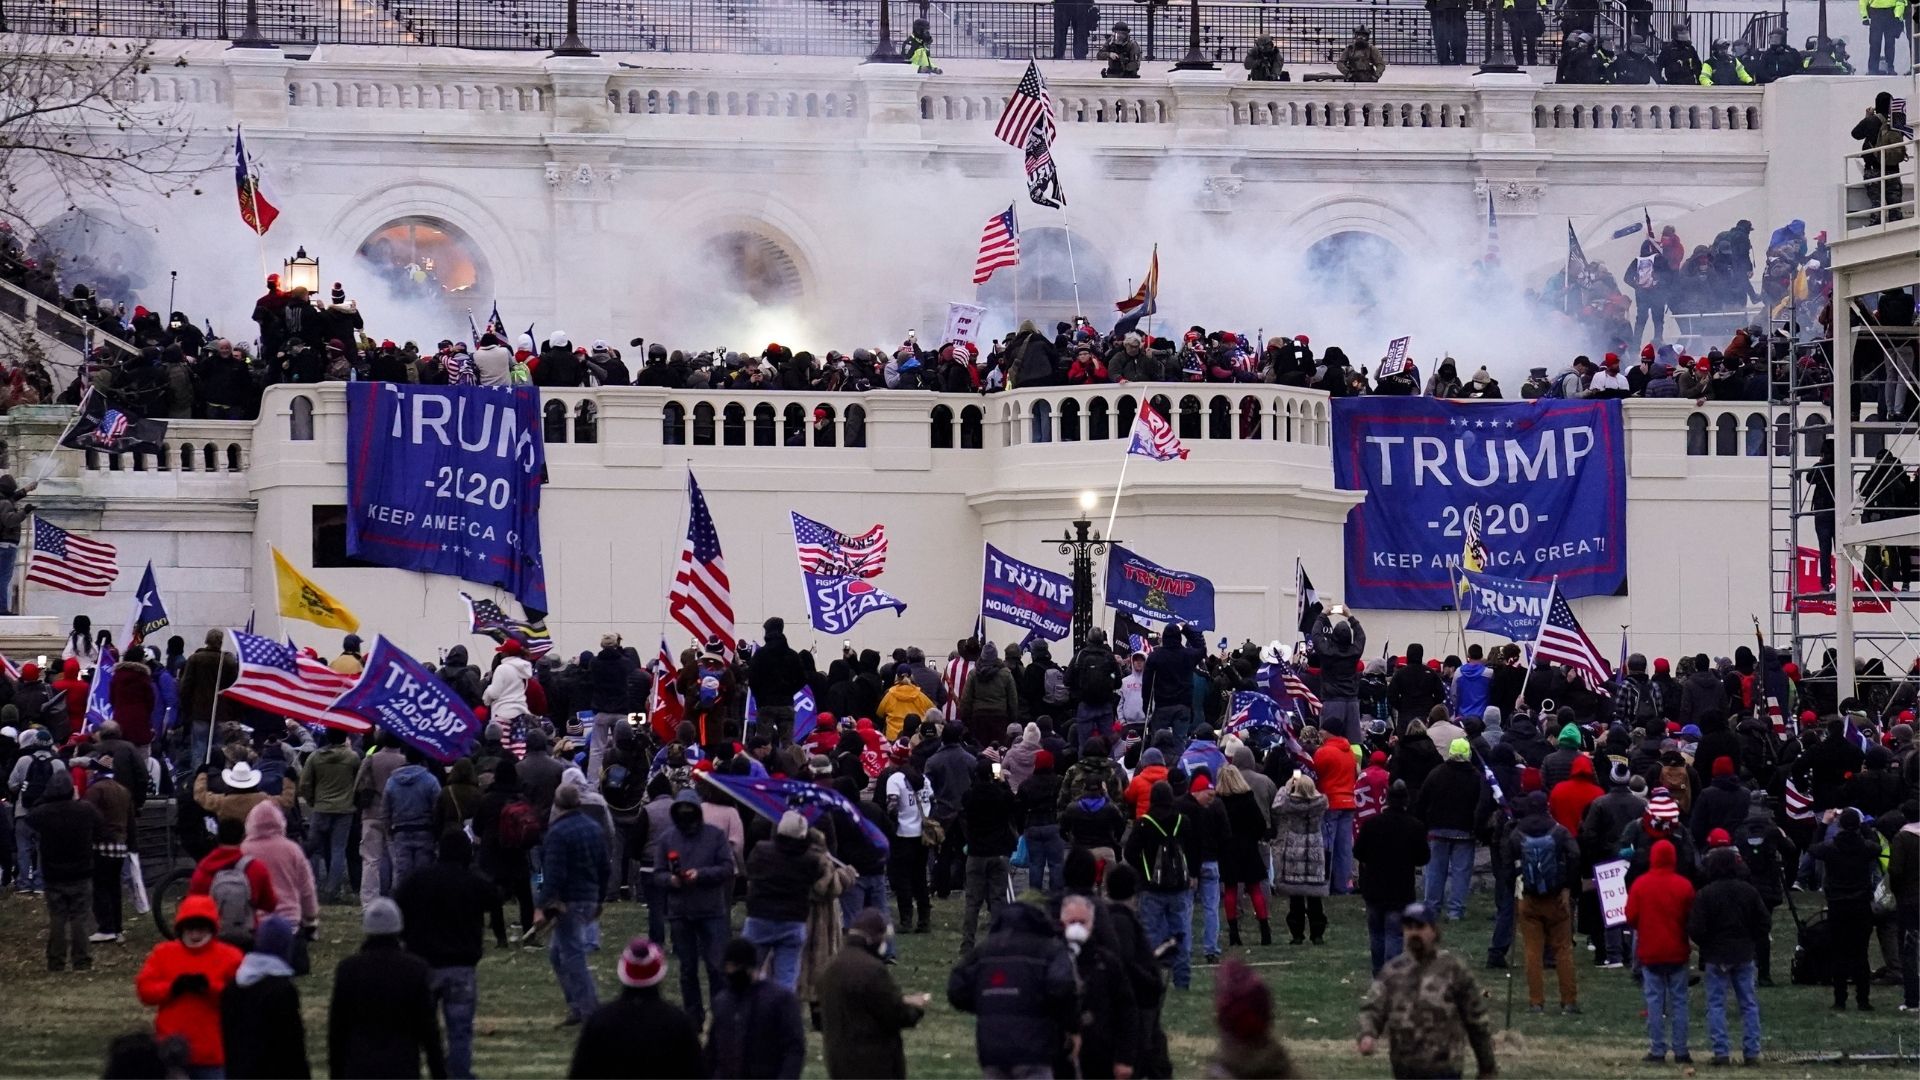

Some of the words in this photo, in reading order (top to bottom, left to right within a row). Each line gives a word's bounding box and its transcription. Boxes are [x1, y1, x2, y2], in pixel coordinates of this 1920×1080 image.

[1365, 425, 1595, 487] TRUMP
[367, 503, 415, 526] KEEP
[422, 514, 496, 541] AMECA
[1373, 550, 1423, 569] KEEP
[1431, 550, 1526, 569] AMICA
[1534, 537, 1606, 563] GREAT!
[990, 553, 1074, 605] TRUMP
[1123, 563, 1196, 598] TRUMP
[822, 593, 894, 632] STEAL
[985, 599, 1001, 610] NO
[1001, 603, 1031, 620] MORE
[1117, 598, 1138, 610] KEEP
[1138, 607, 1173, 619] AMERICA
[1513, 619, 1536, 627] GREAT
[384, 661, 468, 737] TRUMP
[1597, 867, 1621, 880] KEEP
[1602, 889, 1615, 900] TO
